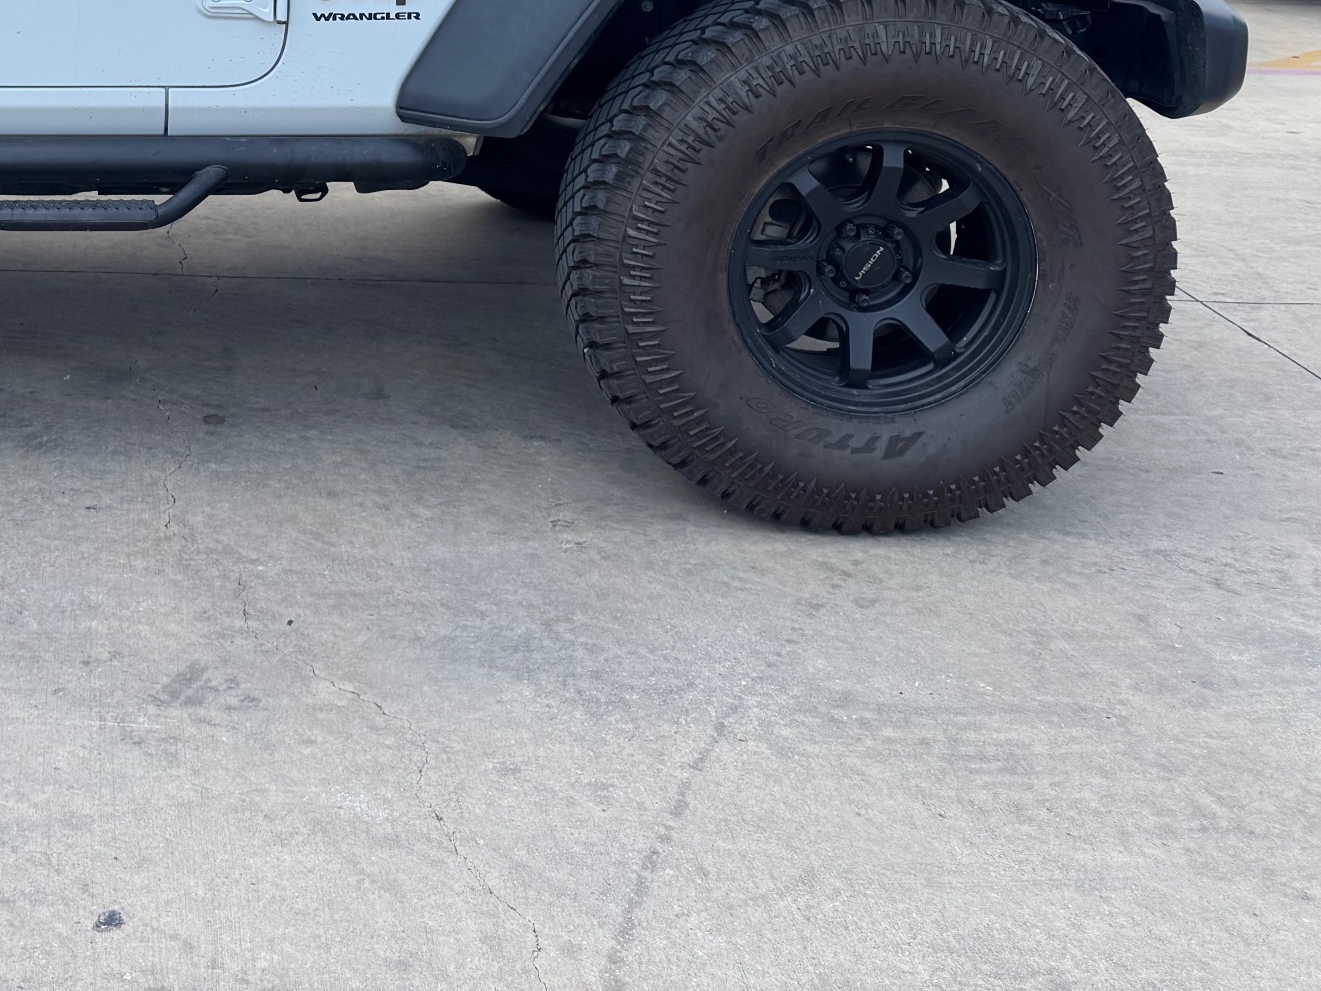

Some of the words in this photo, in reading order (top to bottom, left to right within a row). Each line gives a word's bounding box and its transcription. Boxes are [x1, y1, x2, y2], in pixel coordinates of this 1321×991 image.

[311, 11, 421, 22] WRANGLER
[854, 246, 885, 281] VISION
[743, 396, 926, 460] ATTURO
